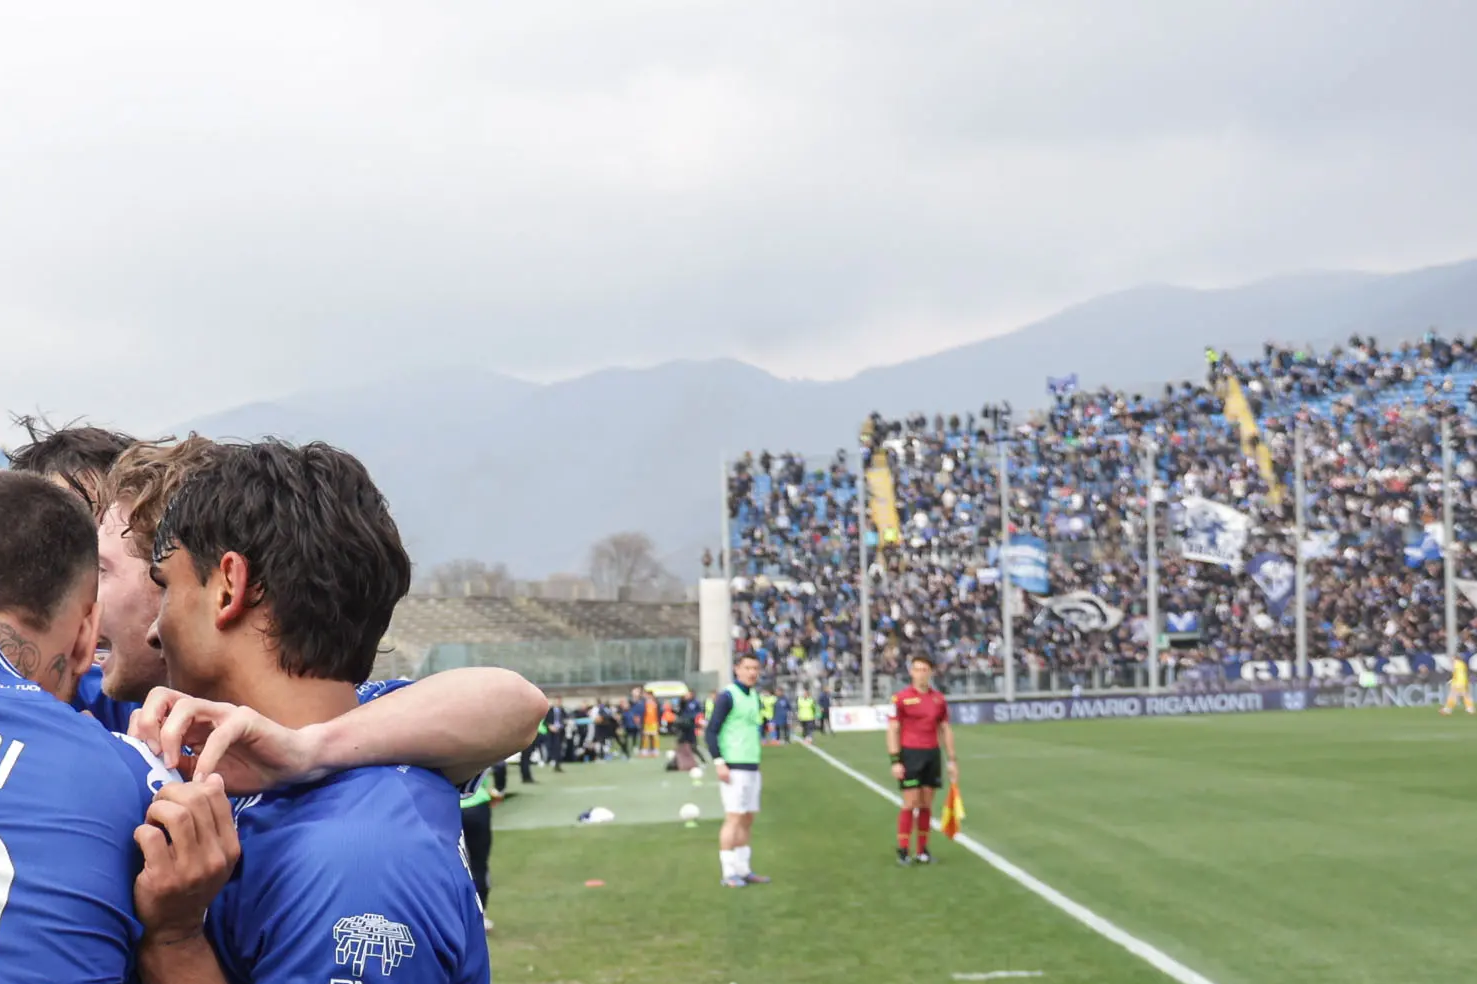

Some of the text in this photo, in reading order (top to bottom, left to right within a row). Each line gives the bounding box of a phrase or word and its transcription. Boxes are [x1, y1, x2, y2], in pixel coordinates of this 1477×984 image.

[993, 692, 1264, 722] STADIO MARIO RIGAMONTI
